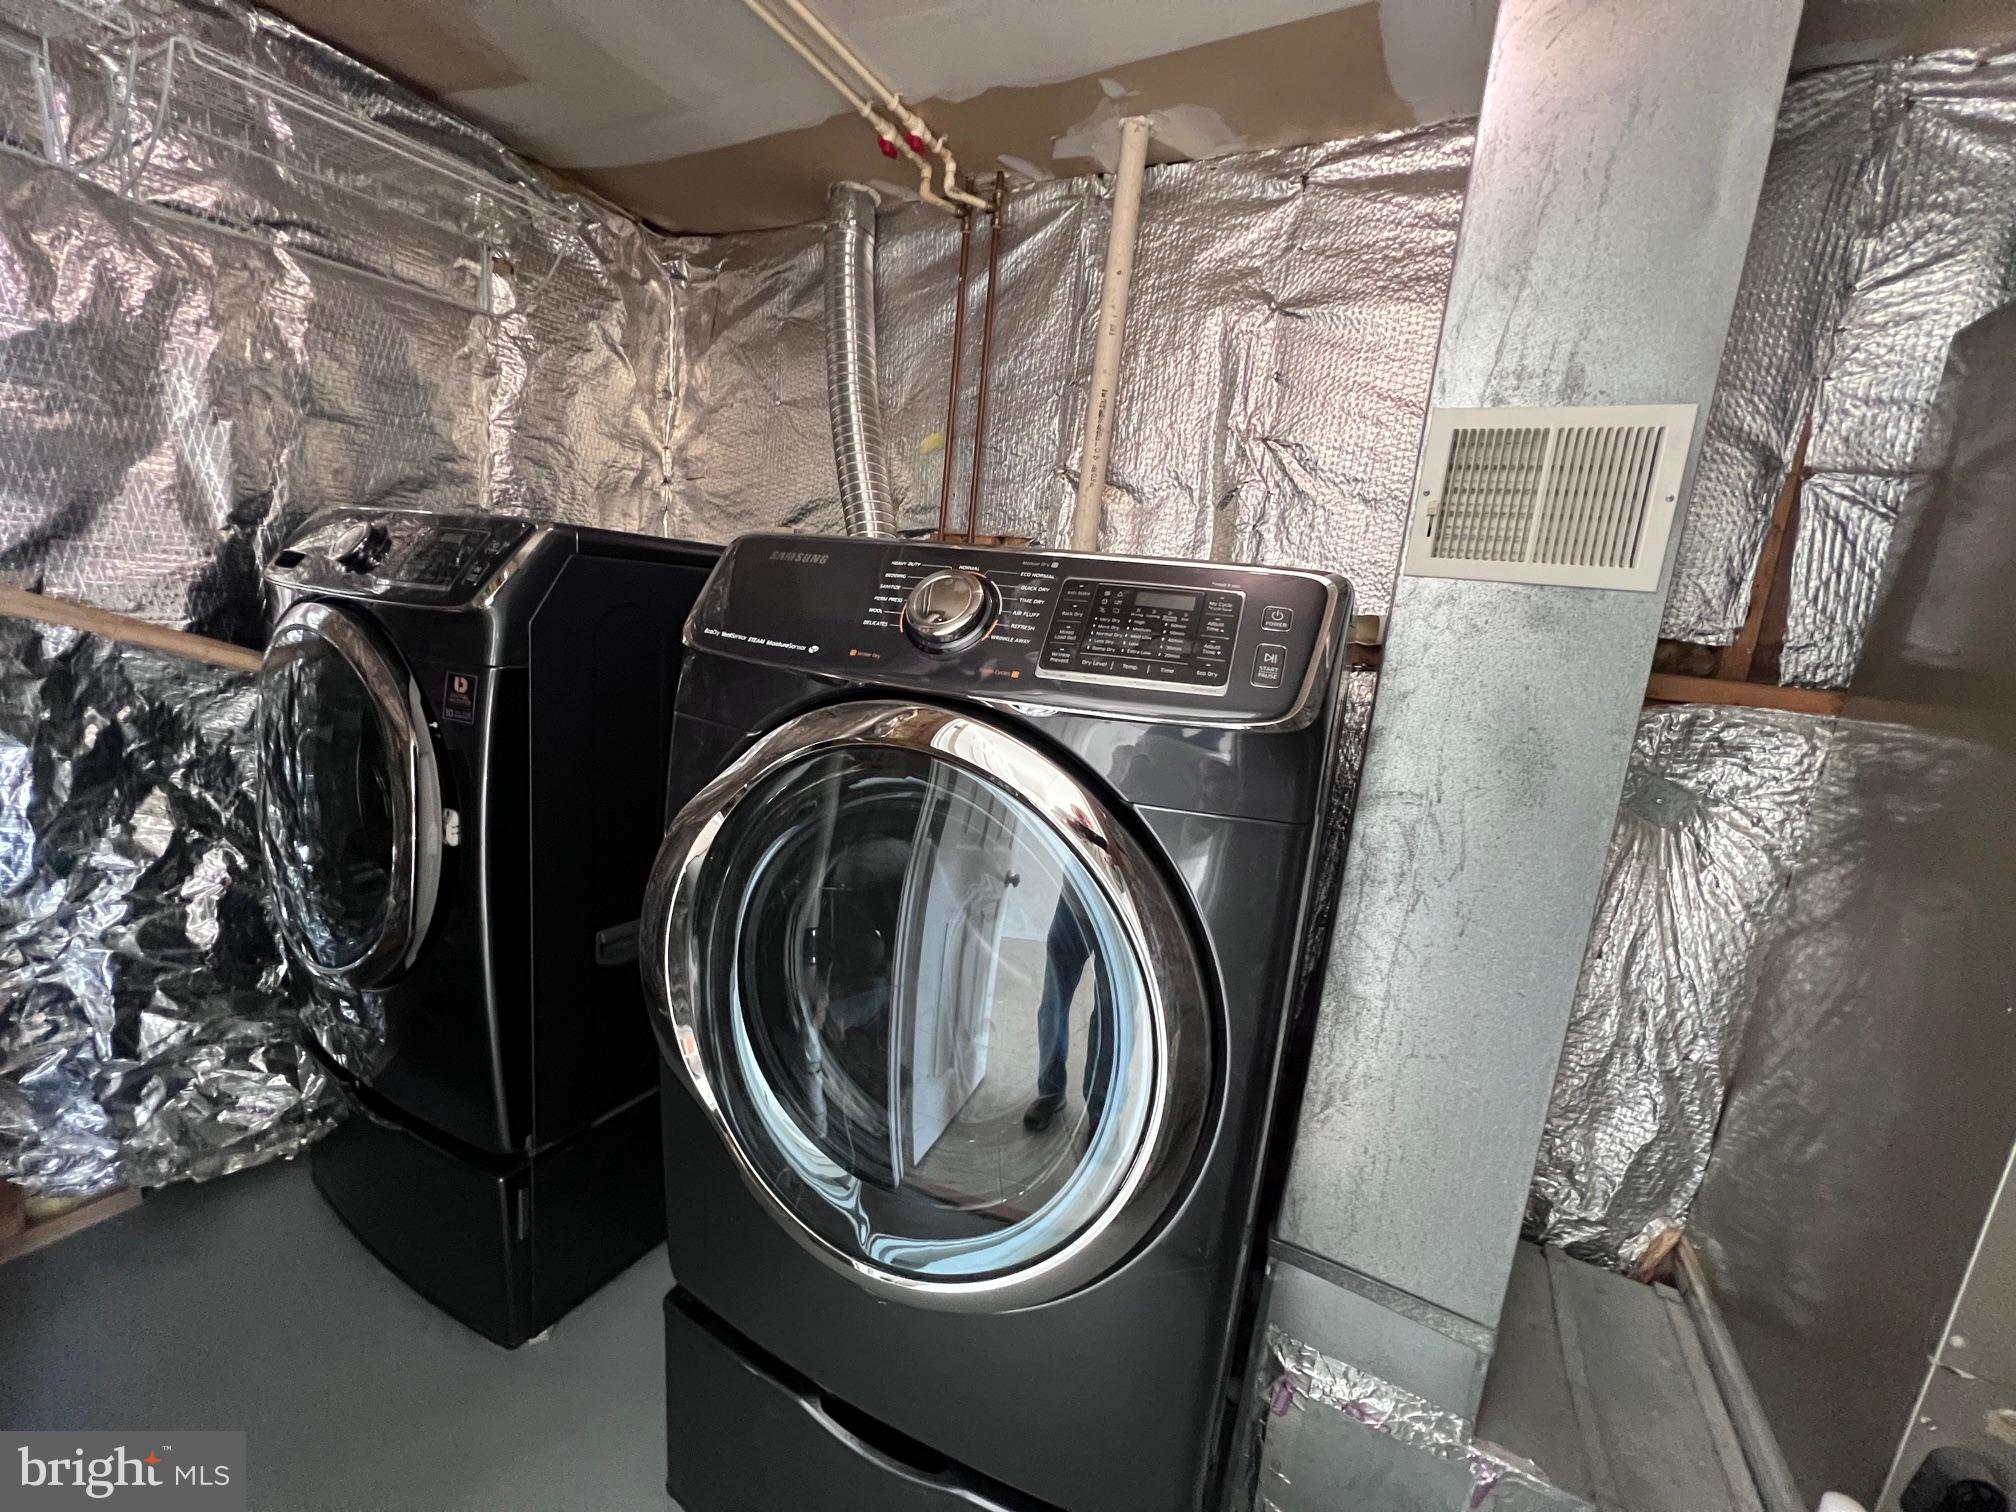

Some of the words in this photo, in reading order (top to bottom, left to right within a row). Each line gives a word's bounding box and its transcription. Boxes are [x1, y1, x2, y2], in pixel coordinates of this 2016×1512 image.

[769, 551, 829, 564] SAMSUNG
[748, 636, 766, 644] STEAM
[991, 635, 1014, 643] WRINKLE
[1257, 672, 1277, 680] PAUSE
